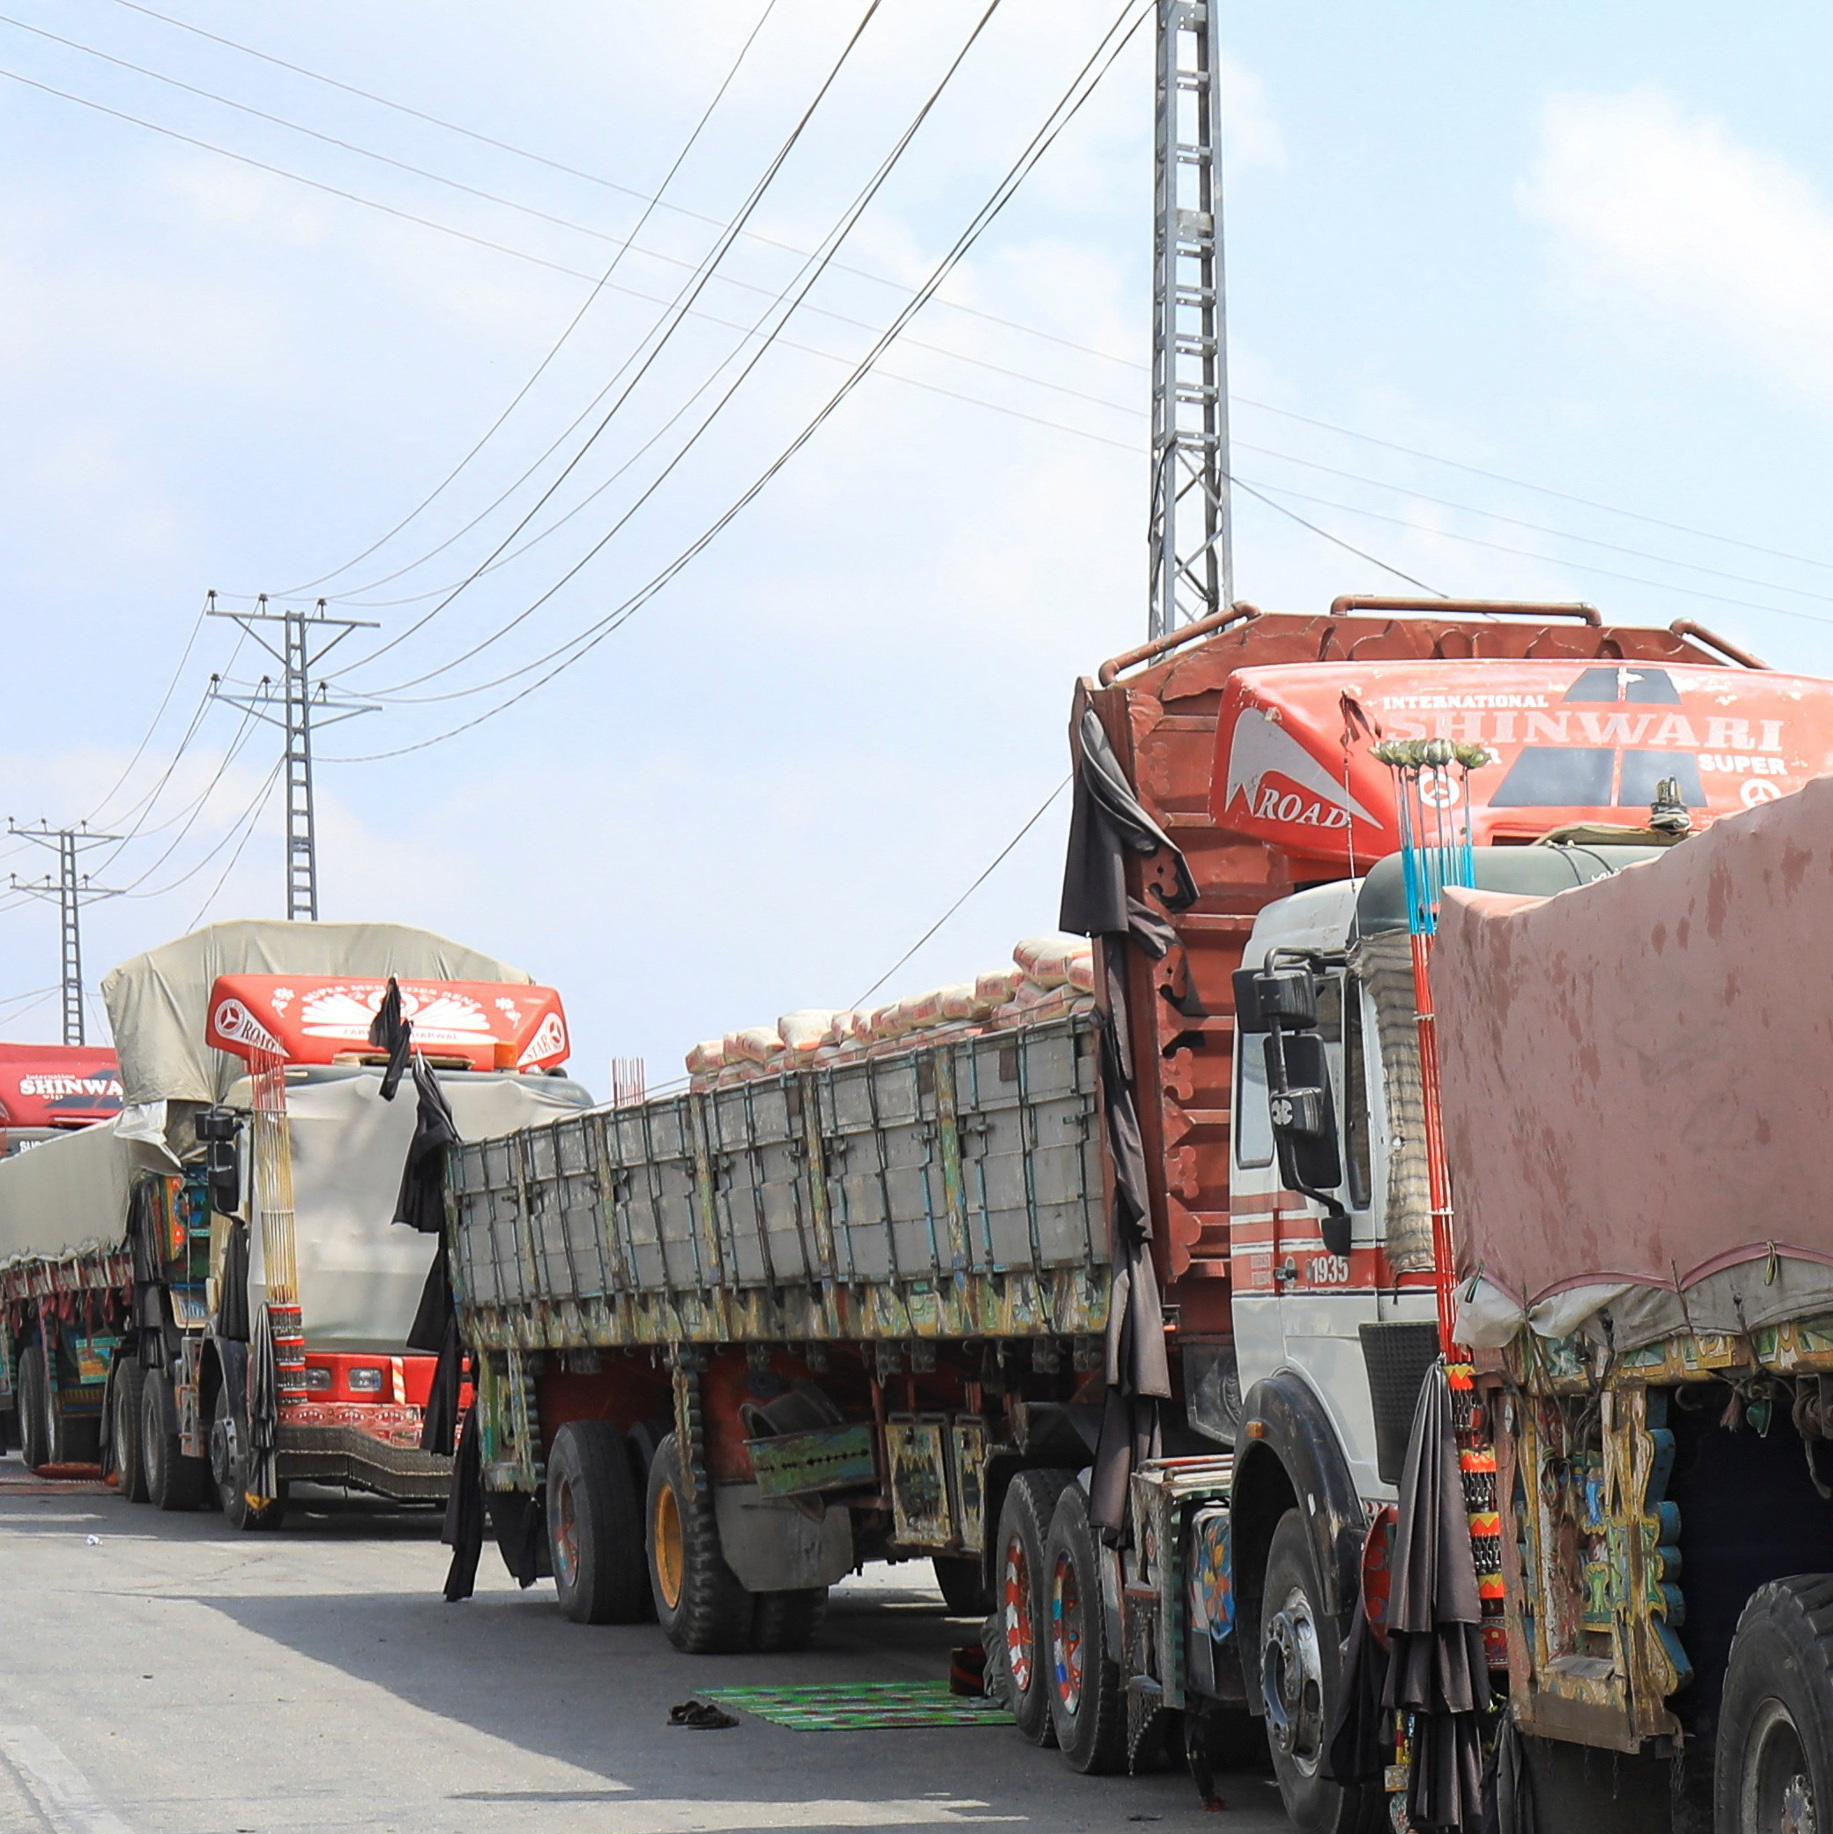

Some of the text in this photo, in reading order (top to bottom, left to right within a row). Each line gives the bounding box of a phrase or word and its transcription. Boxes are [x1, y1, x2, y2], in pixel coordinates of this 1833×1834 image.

[1383, 695, 1549, 710] INTERNATIONAL
[1386, 709, 1785, 752] SHINWARI
[1699, 753, 1788, 776] SUPER
[1253, 787, 1351, 828] ROAD
[350, 983, 438, 996] MEREDES
[241, 1019, 276, 1051] ROAD
[526, 1034, 553, 1060] STAR
[19, 1079, 124, 1096] SHINWA
[1311, 1254, 1349, 1284] 1935
